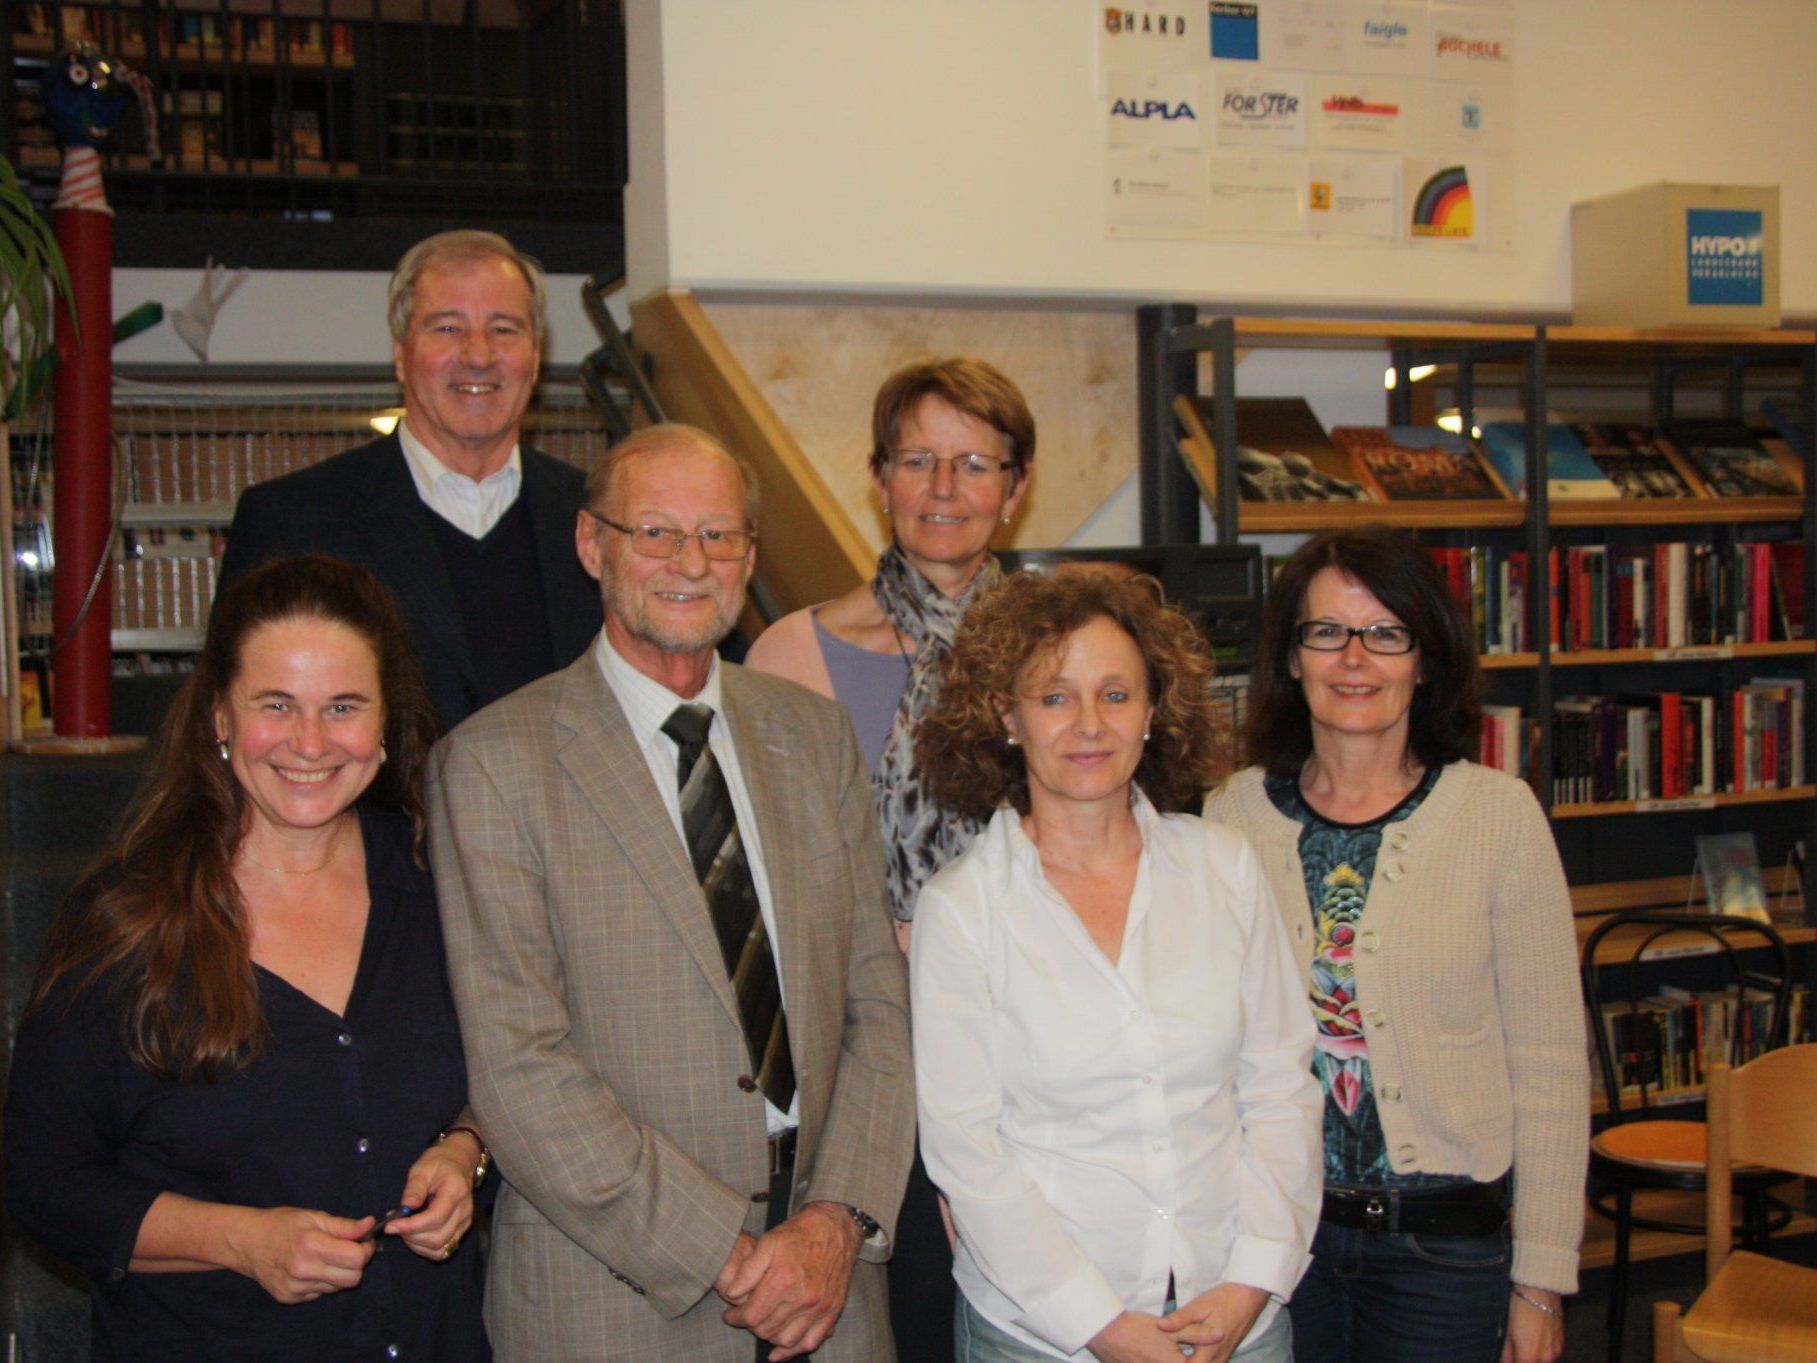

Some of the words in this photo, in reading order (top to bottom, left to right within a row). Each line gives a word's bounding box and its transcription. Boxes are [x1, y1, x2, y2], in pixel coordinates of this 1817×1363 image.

[1125, 12, 1186, 36] HARD
[1110, 97, 1196, 120] ALPLA
[1223, 92, 1299, 119] FORSTER
[1691, 236, 1746, 256] HYPO
